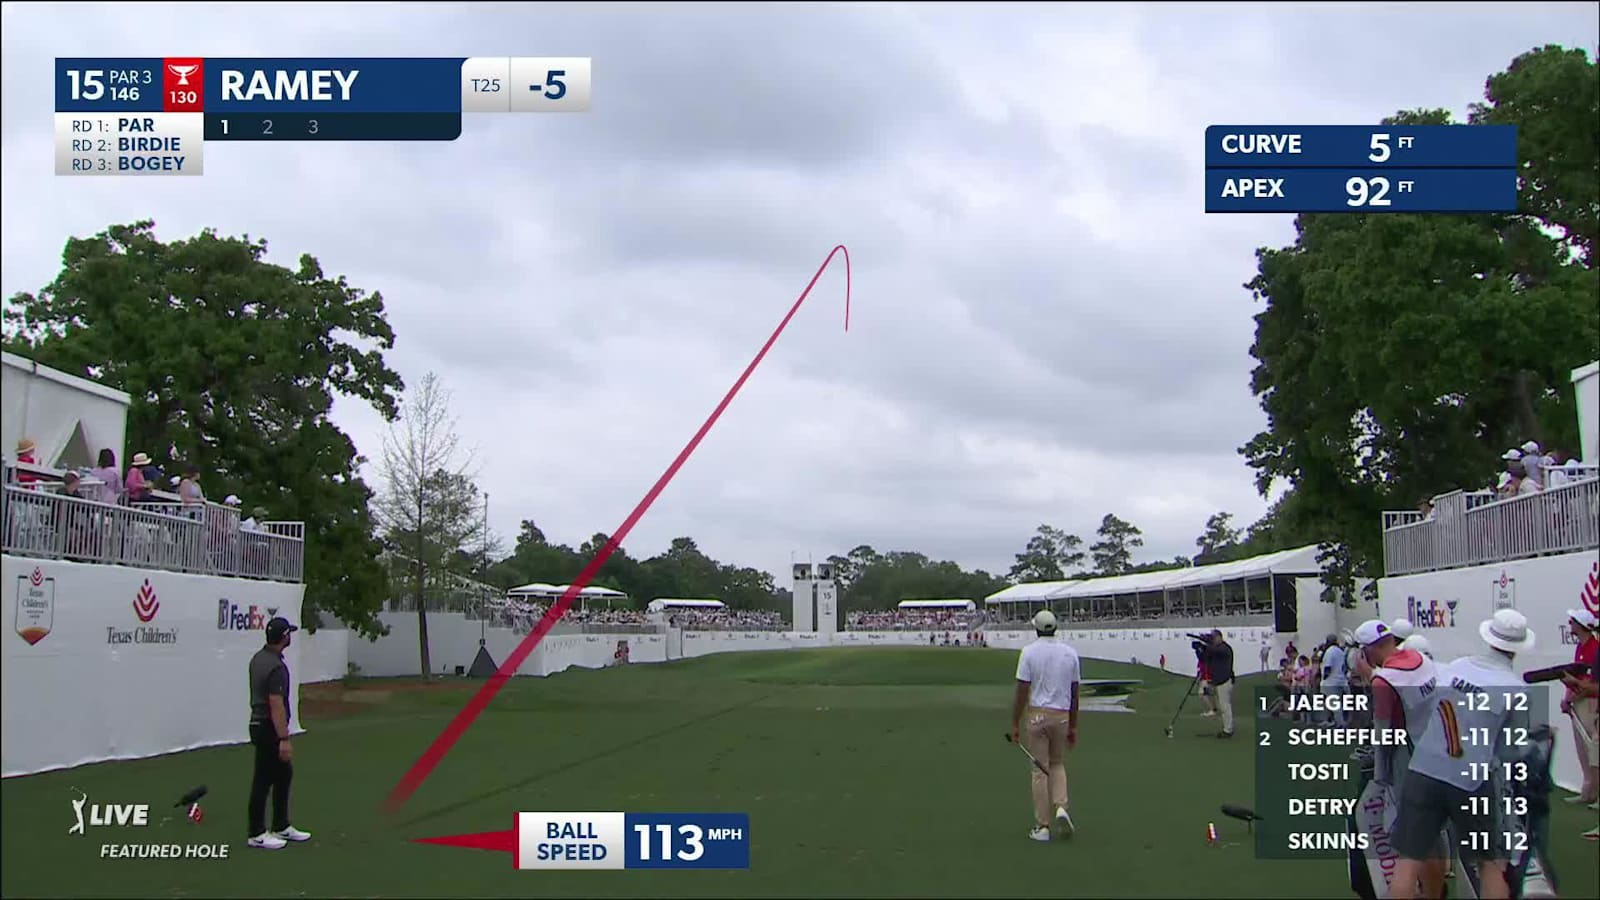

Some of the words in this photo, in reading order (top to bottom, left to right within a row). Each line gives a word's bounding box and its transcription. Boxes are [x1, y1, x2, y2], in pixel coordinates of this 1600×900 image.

[229, 604, 265, 630] FedEx
[1416, 599, 1446, 628] FedEx
[106, 626, 132, 645] Texas
[134, 626, 178, 645] Children's
